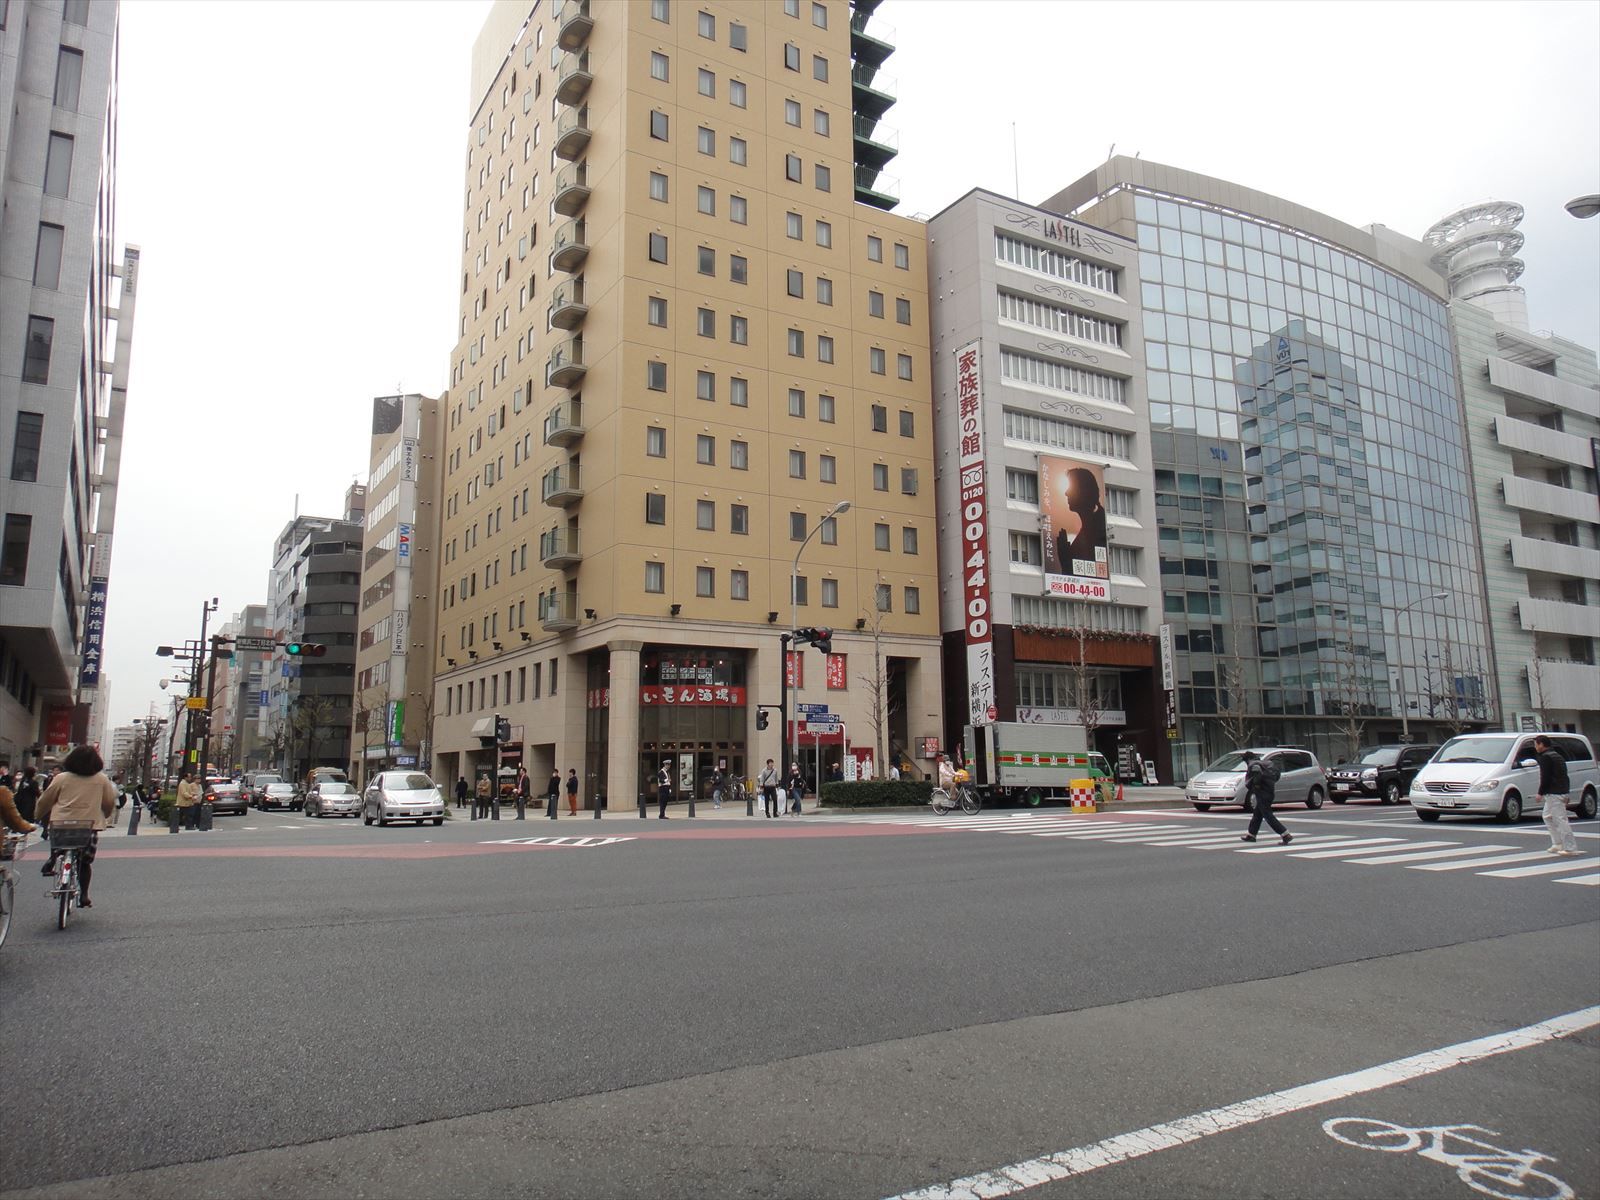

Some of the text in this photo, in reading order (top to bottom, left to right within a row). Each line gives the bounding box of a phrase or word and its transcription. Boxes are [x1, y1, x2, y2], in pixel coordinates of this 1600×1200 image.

[1043, 218, 1082, 248] LASTEL
[958, 349, 981, 458] 家族葬の館
[963, 486, 984, 500] 0120
[399, 523, 410, 557] MACH
[1063, 582, 1105, 597] 00-44-00
[83, 591, 106, 675] 横浜信用金庫
[979, 649, 991, 716] ラステル
[1051, 711, 1069, 721] LASTEL
